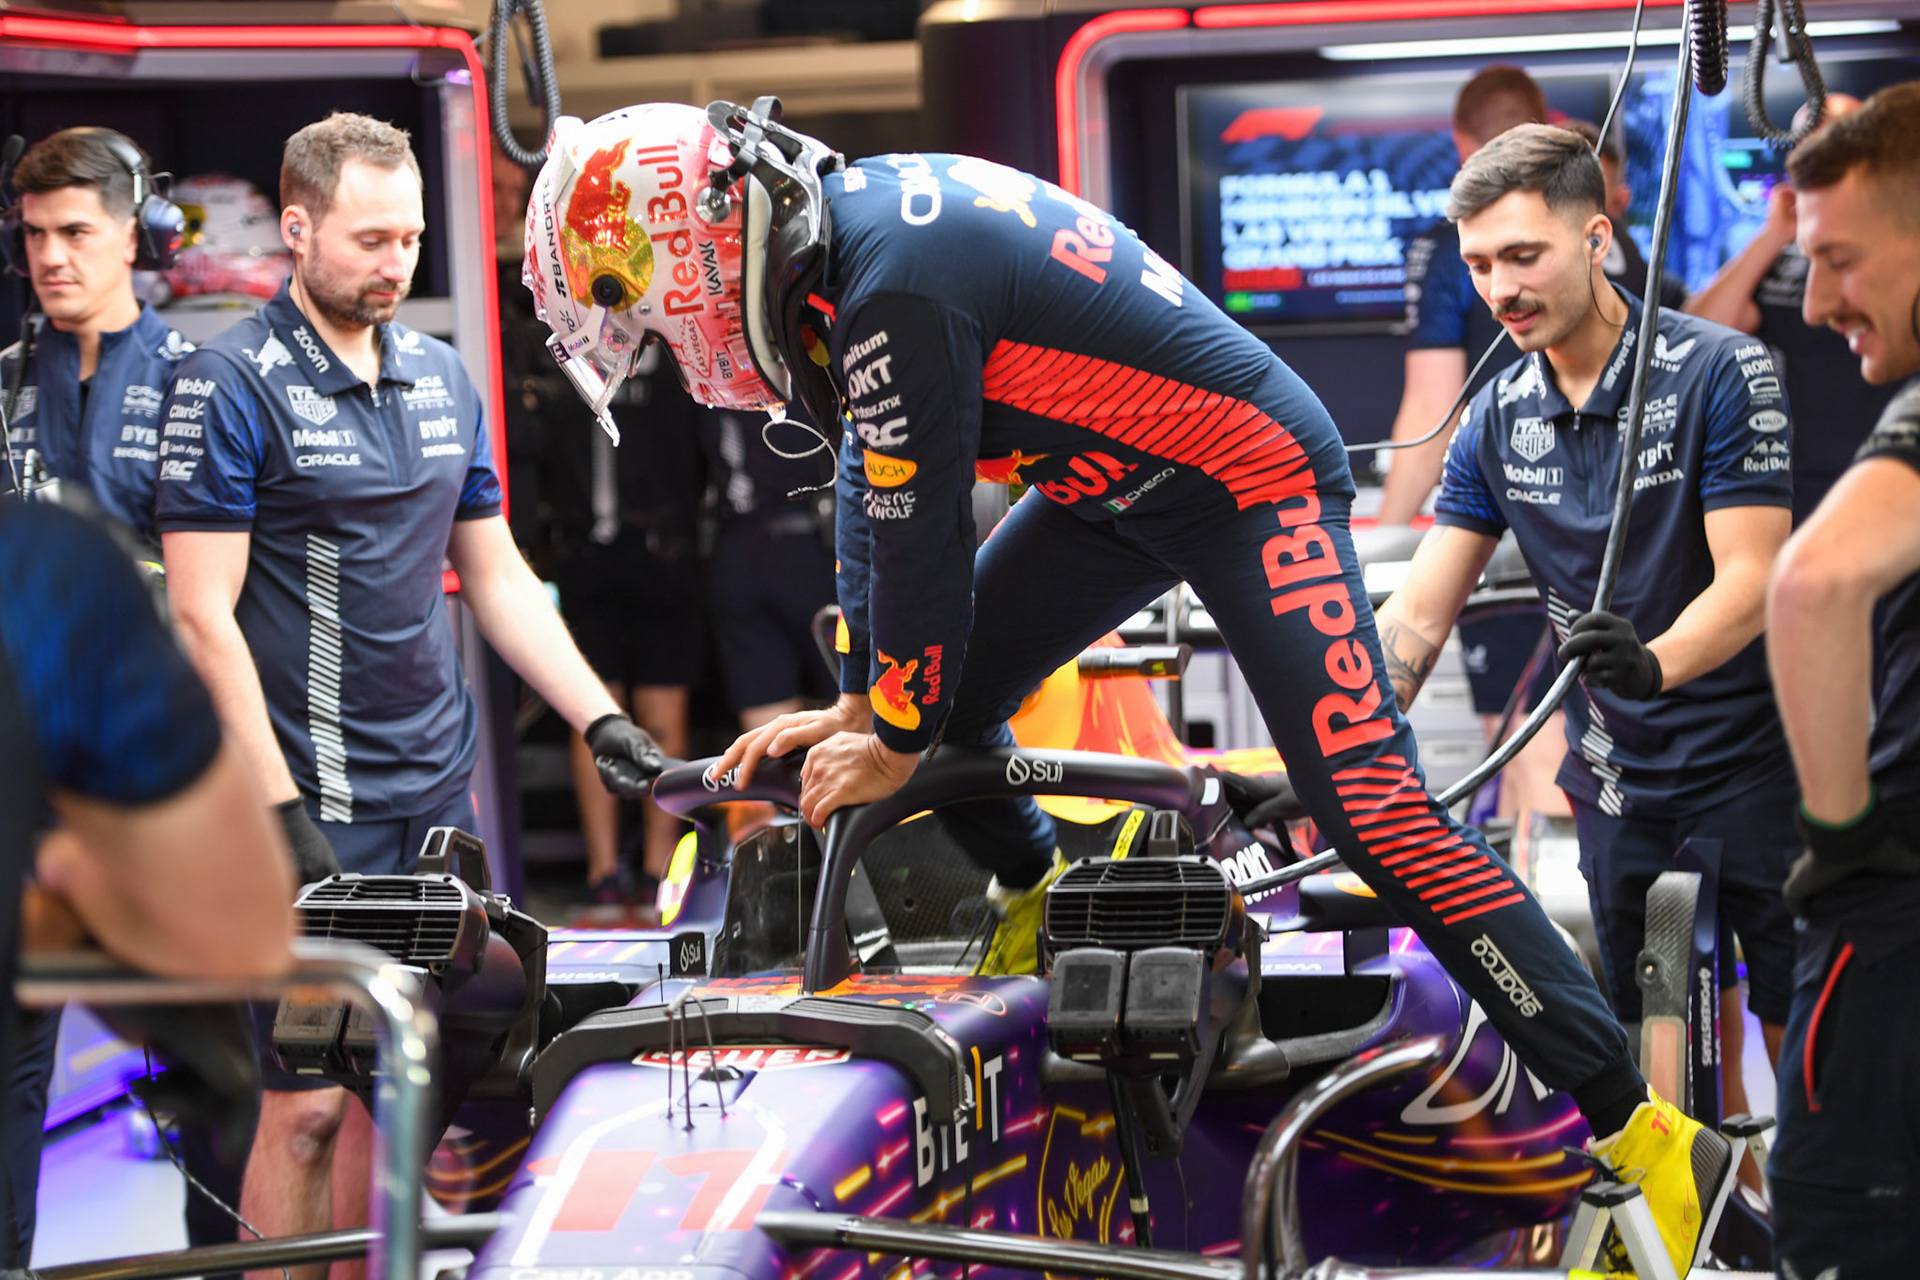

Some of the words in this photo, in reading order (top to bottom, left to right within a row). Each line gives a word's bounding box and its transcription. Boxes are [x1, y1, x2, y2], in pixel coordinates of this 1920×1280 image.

[543, 178, 562, 277] BANORTE
[698, 240, 723, 296] KAVAK
[292, 325, 330, 373] zoom
[175, 378, 216, 397] Mobil
[848, 354, 892, 399] OKT
[169, 401, 203, 419] Claro
[121, 425, 158, 446] BYB
[292, 428, 339, 447] Mobil
[856, 416, 908, 448] RC
[1514, 436, 1552, 456] HEUER
[1638, 441, 1675, 471] YBIT
[296, 453, 361, 467] ORACLE
[868, 462, 907, 478] AUCH
[1125, 467, 1176, 502] CHECO
[1503, 463, 1546, 485] Mobil
[1634, 468, 1685, 491] ONDA
[874, 505, 913, 521] WOLF
[1032, 759, 1063, 783] Sui
[1471, 933, 1543, 1018] sparco
[1651, 1109, 1672, 1137] 11
[1064, 1155, 1110, 1221] Vegas
